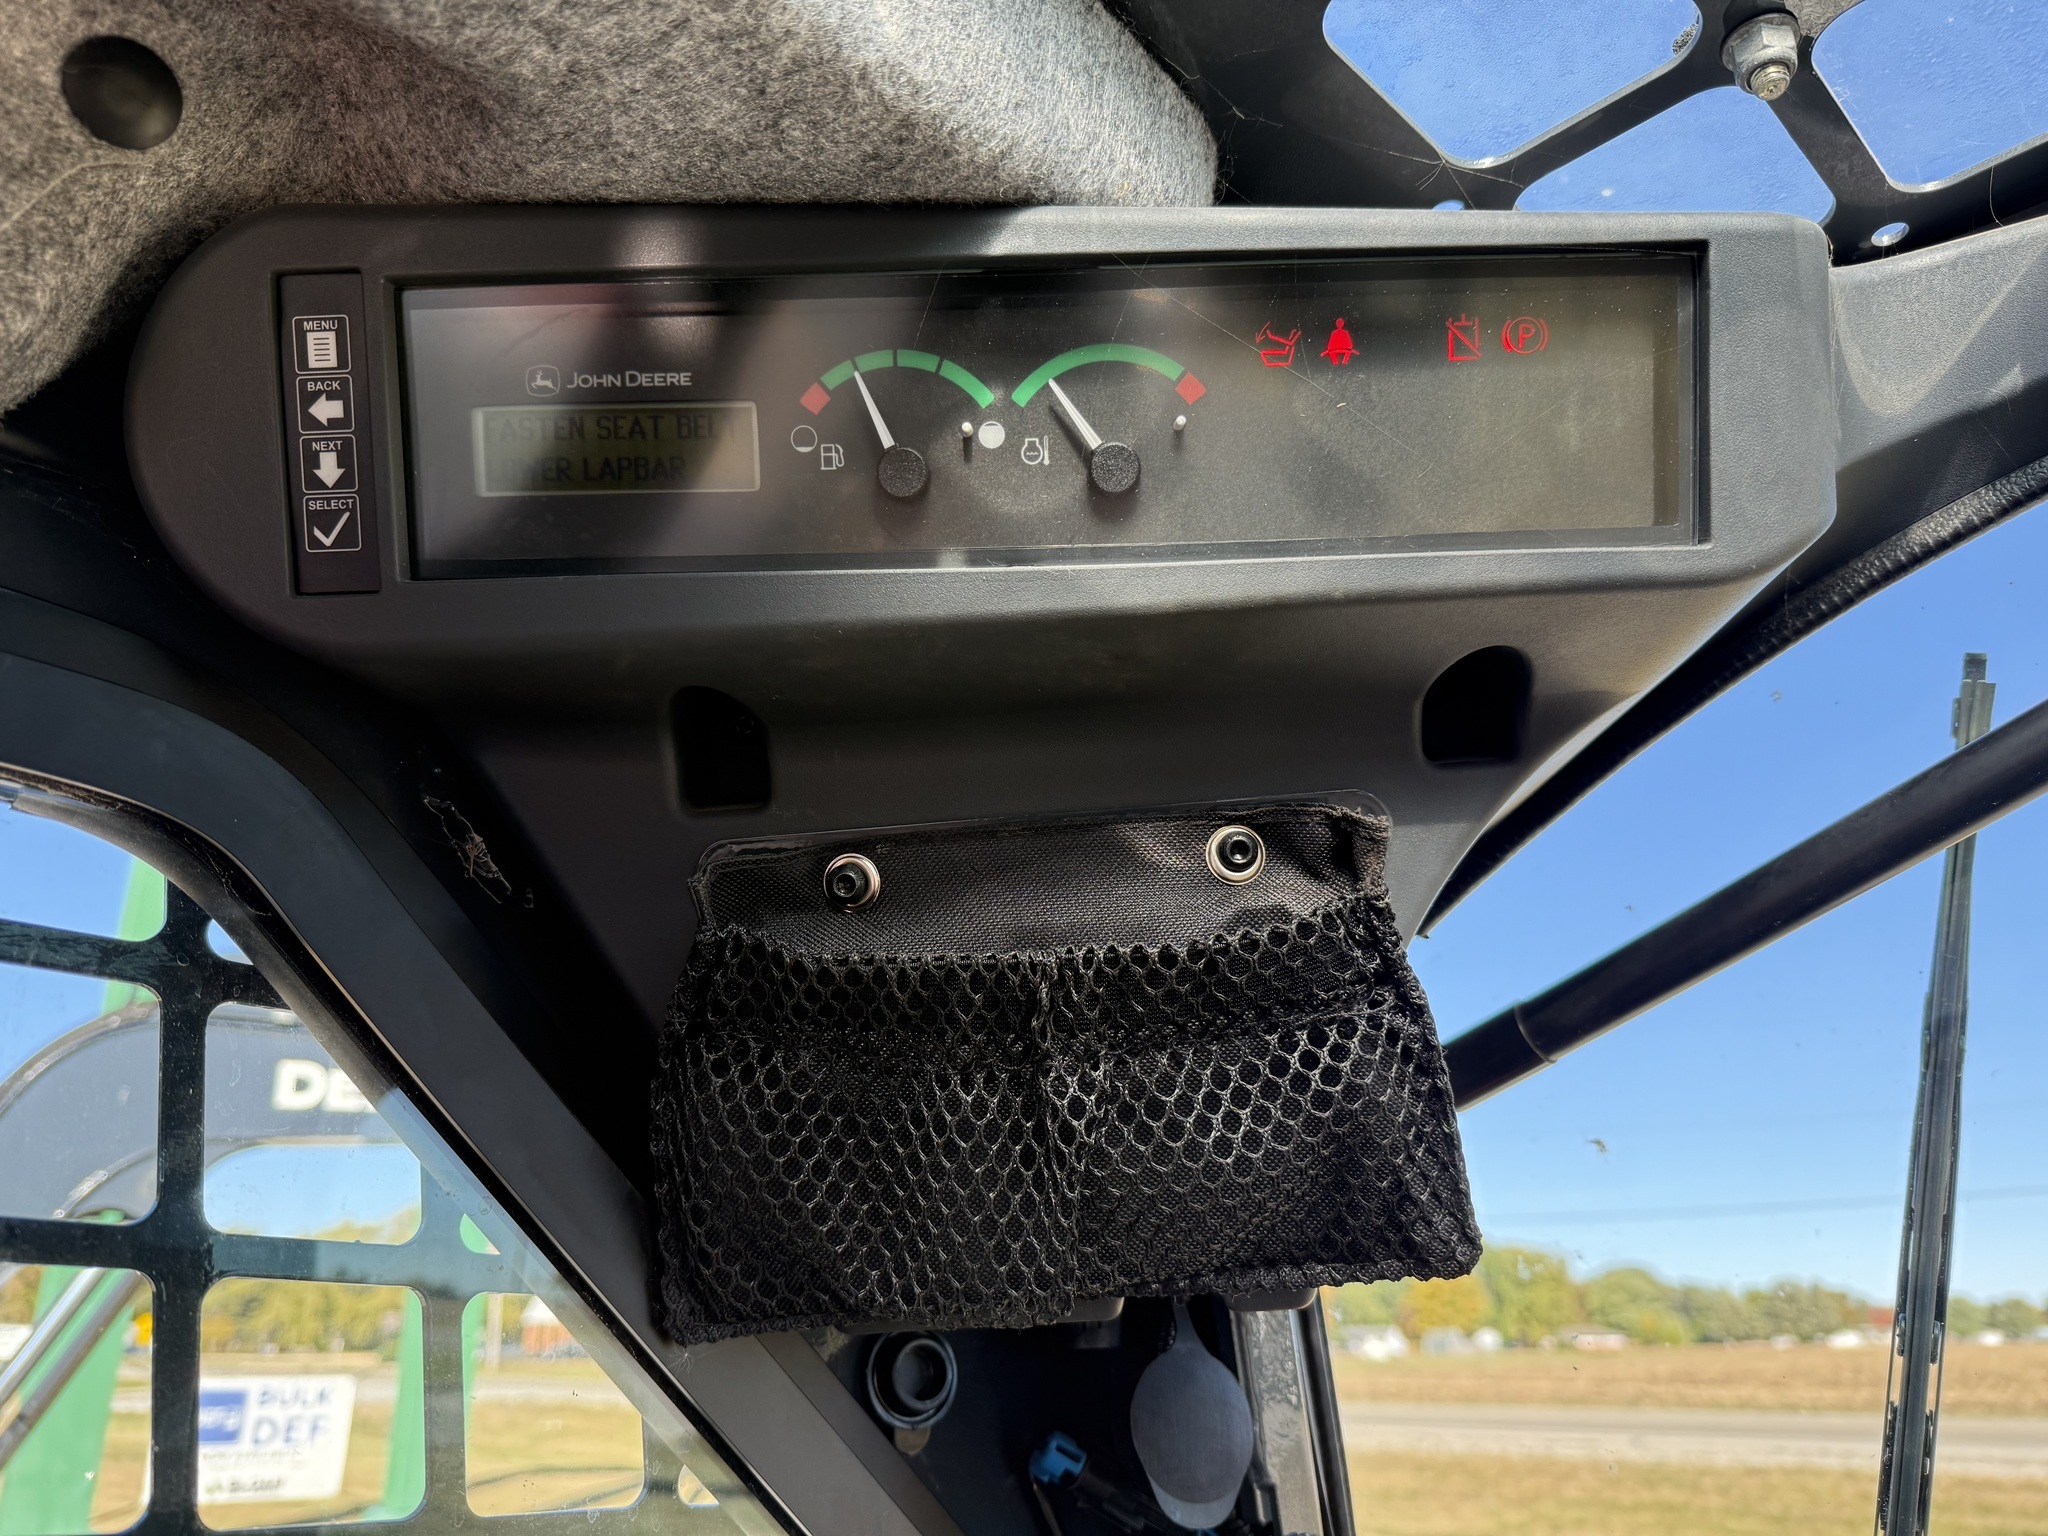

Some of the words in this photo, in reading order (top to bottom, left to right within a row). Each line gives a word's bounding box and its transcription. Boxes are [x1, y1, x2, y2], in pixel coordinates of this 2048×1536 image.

[303, 320, 338, 331] MENU
[307, 380, 341, 392] BACK
[566, 371, 622, 389] JOHN
[625, 370, 692, 387] DEERE
[596, 415, 663, 440] SEAT
[676, 414, 737, 440] BEL
[312, 440, 343, 451] NEXT
[582, 456, 687, 482] LAPBAR
[308, 499, 354, 511] SELECT
[271, 1058, 378, 1113] DE
[258, 1386, 333, 1407] BULK
[252, 1415, 330, 1447] DEF
